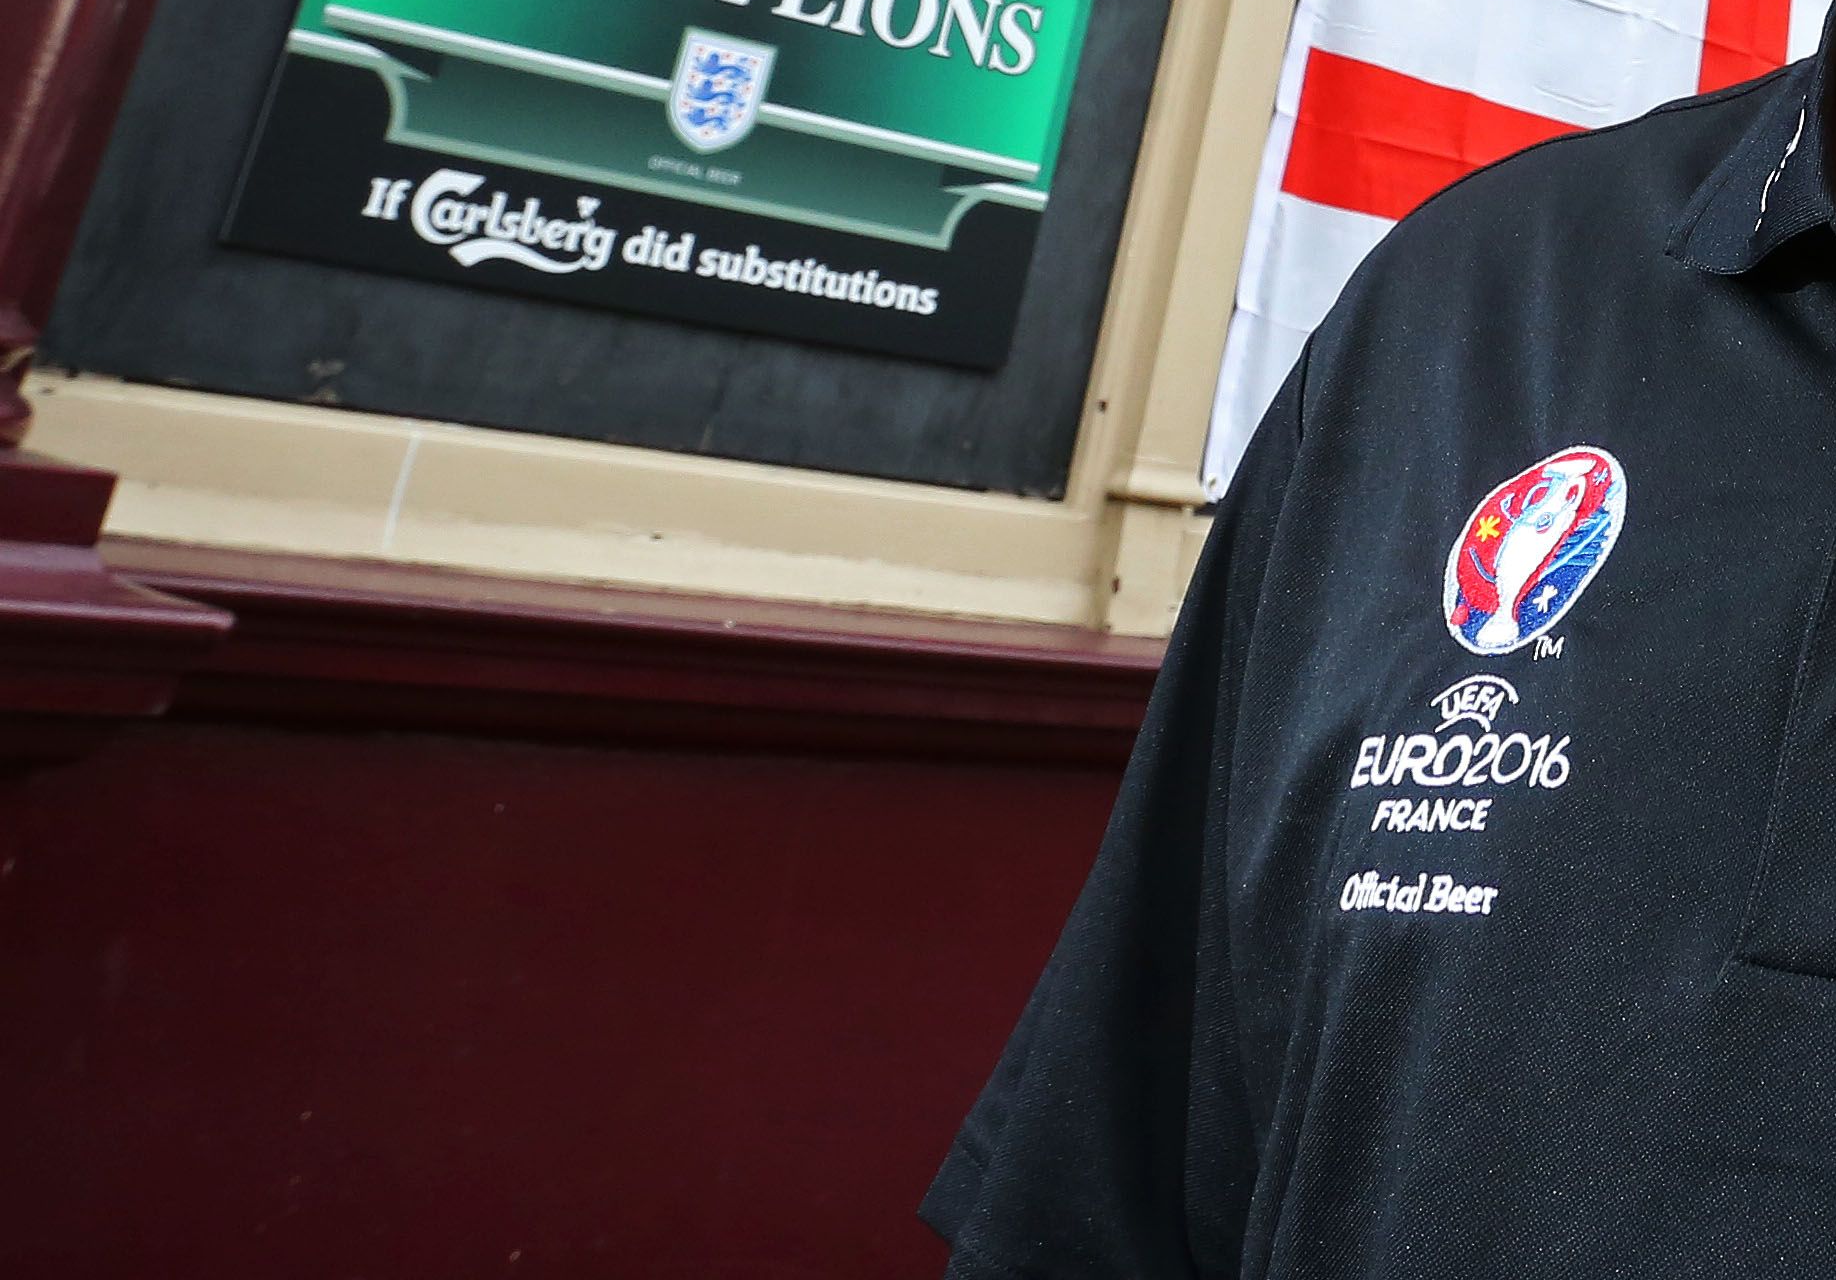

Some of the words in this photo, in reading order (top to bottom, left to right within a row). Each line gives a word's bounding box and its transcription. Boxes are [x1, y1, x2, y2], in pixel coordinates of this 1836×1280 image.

[361, 177, 413, 221] If
[410, 167, 617, 274] Carlsberg
[622, 226, 692, 273] did
[696, 244, 940, 316] substitutions
[1441, 684, 1506, 721] UEFA
[1370, 798, 1493, 833] FRANCE
[1340, 869, 1428, 913] Official
[1423, 874, 1499, 915] Beer
